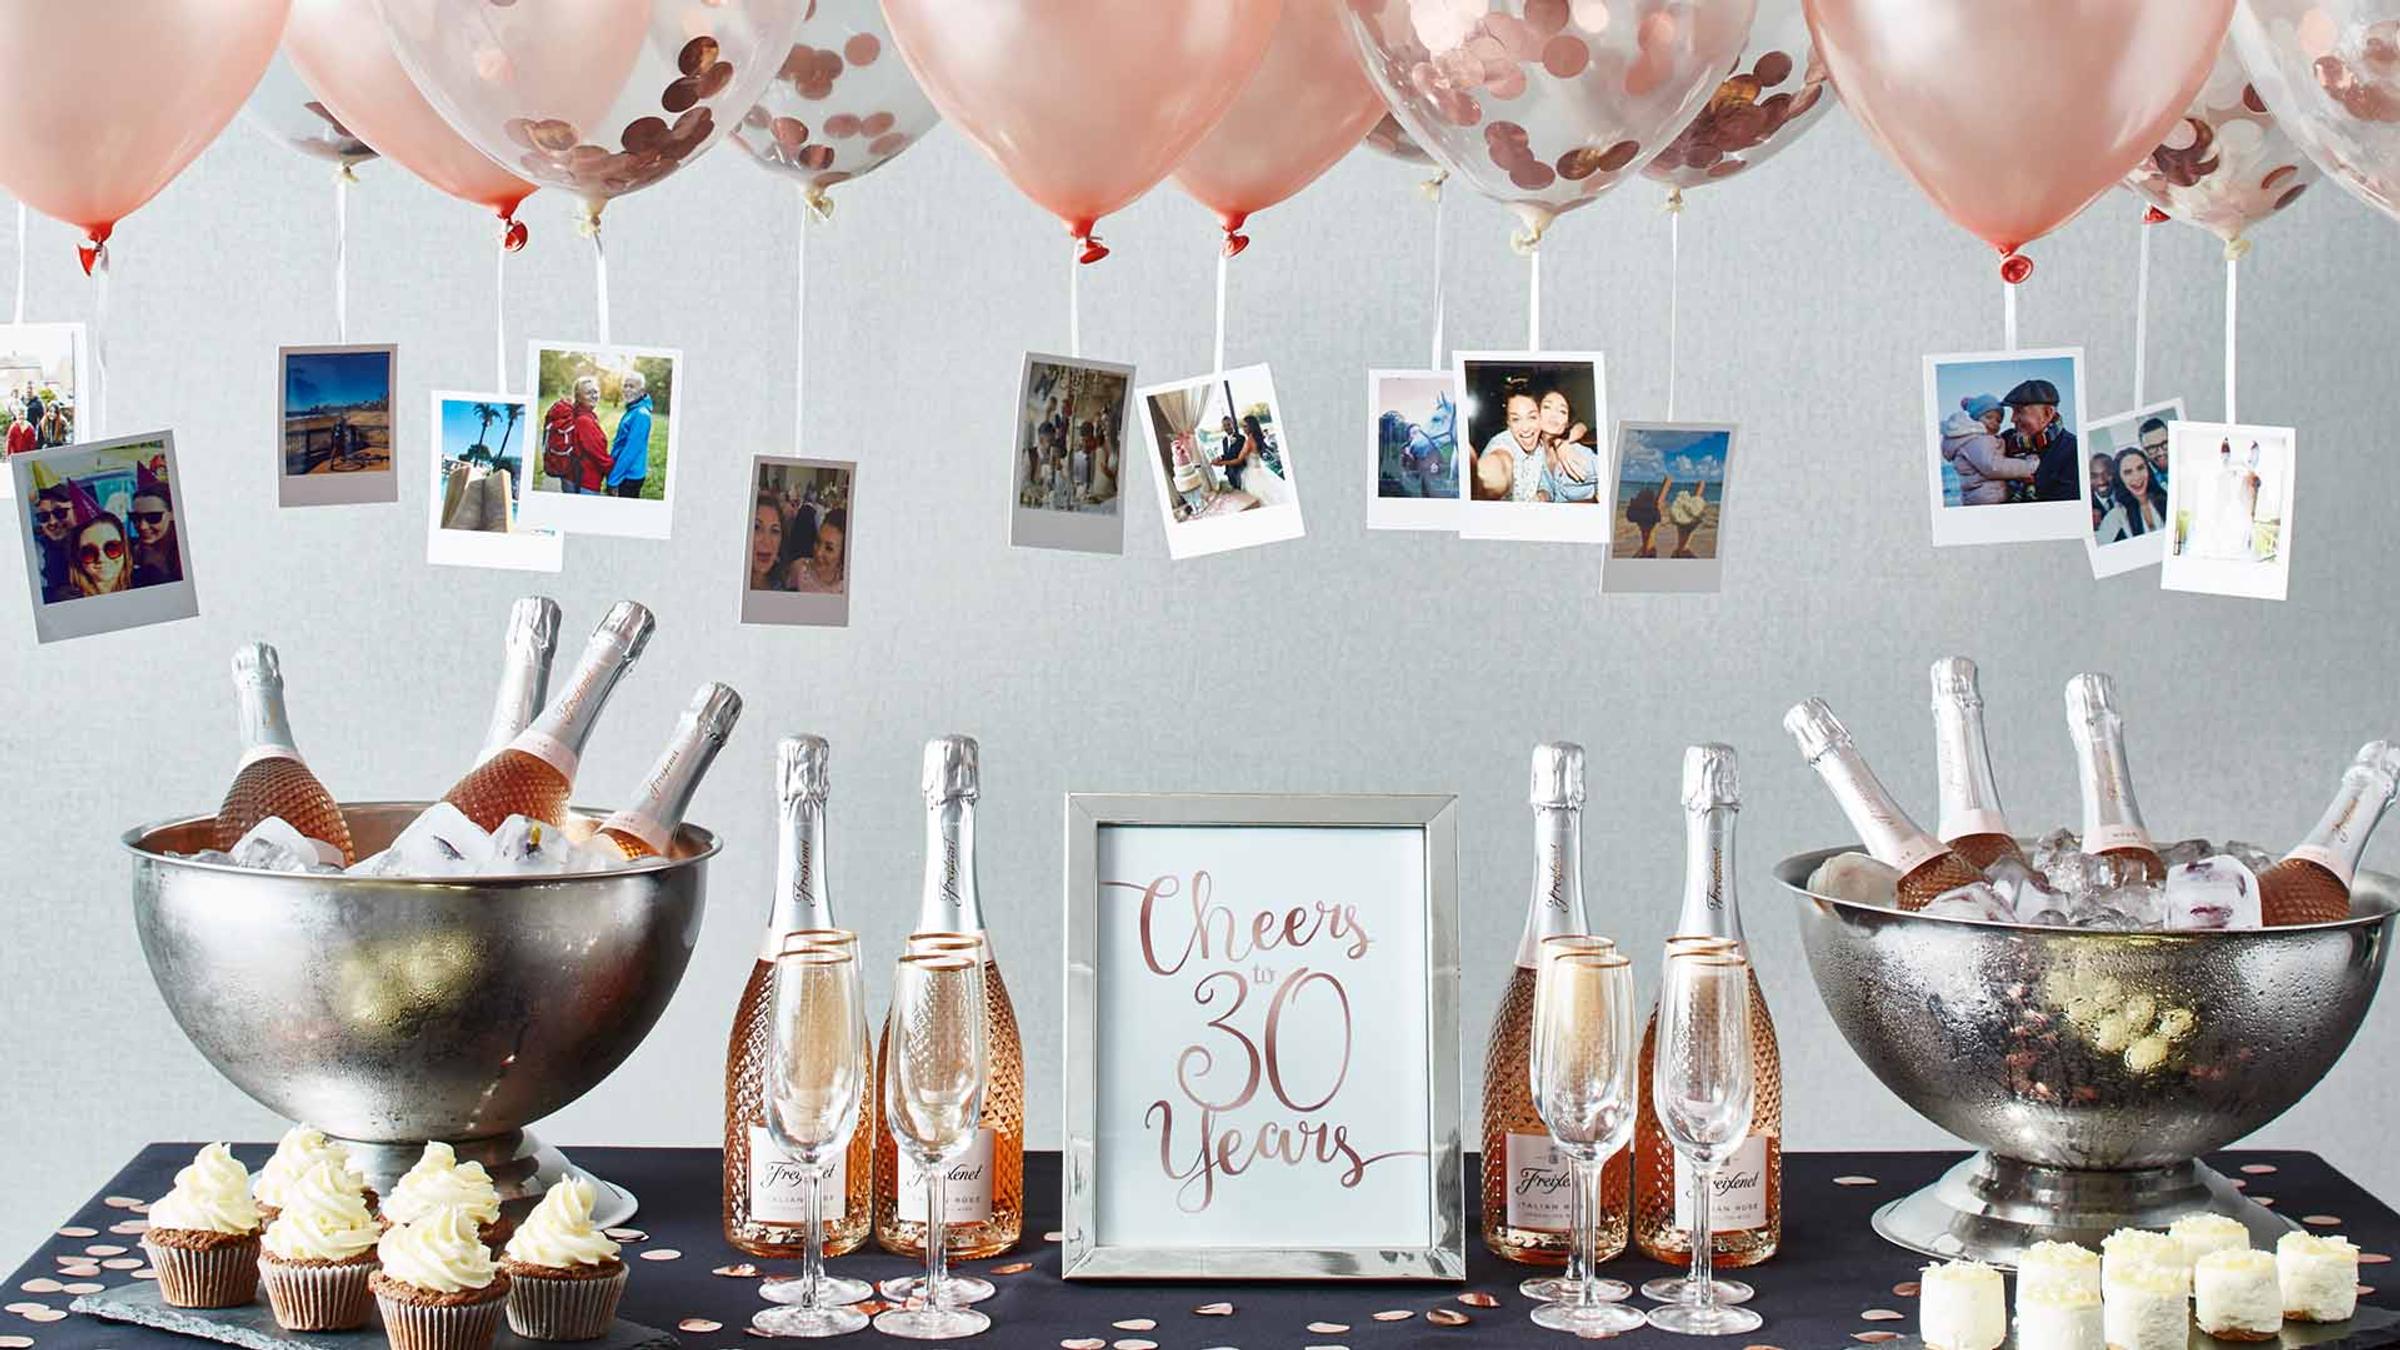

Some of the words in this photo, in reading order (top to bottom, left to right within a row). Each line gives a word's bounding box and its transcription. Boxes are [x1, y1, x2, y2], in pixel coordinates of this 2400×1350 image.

[1101, 870, 1376, 976] Cheers
[1253, 965, 1276, 985] to
[1178, 967, 1351, 1112] 30
[1145, 1100, 1429, 1213] Years
[1516, 1167, 1570, 1195] Freixe
